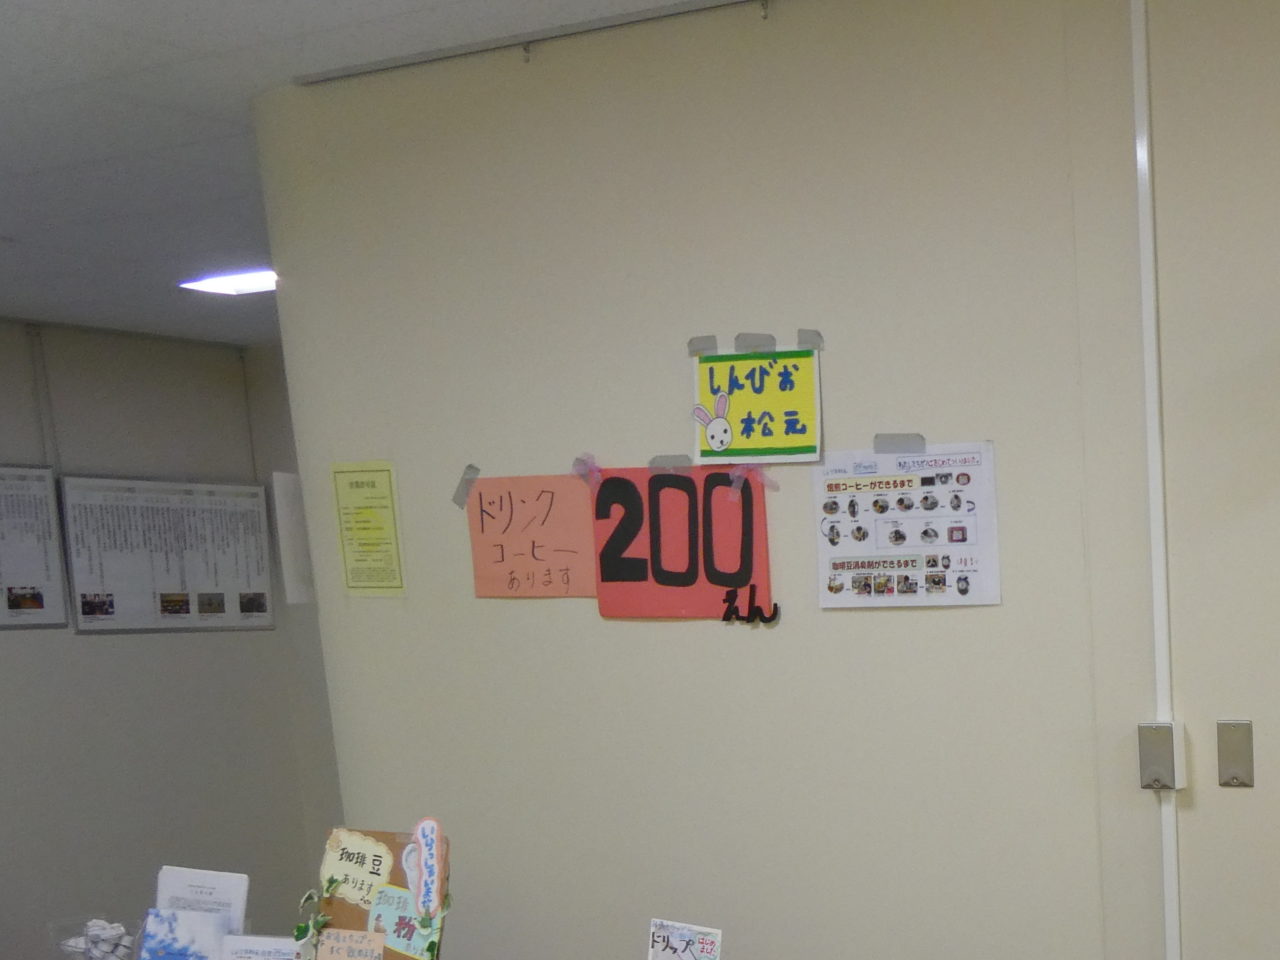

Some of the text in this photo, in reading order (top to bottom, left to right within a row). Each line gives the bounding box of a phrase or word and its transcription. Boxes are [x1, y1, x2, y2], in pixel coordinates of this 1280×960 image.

[708, 358, 799, 396] しんびお
[740, 410, 807, 439] 松元
[595, 472, 754, 588] 200
[493, 539, 579, 563] コーヒー
[507, 567, 571, 595] あります
[338, 847, 383, 877] 珈琲豆
[341, 874, 374, 896] あります
[650, 931, 694, 955] ドリップ
